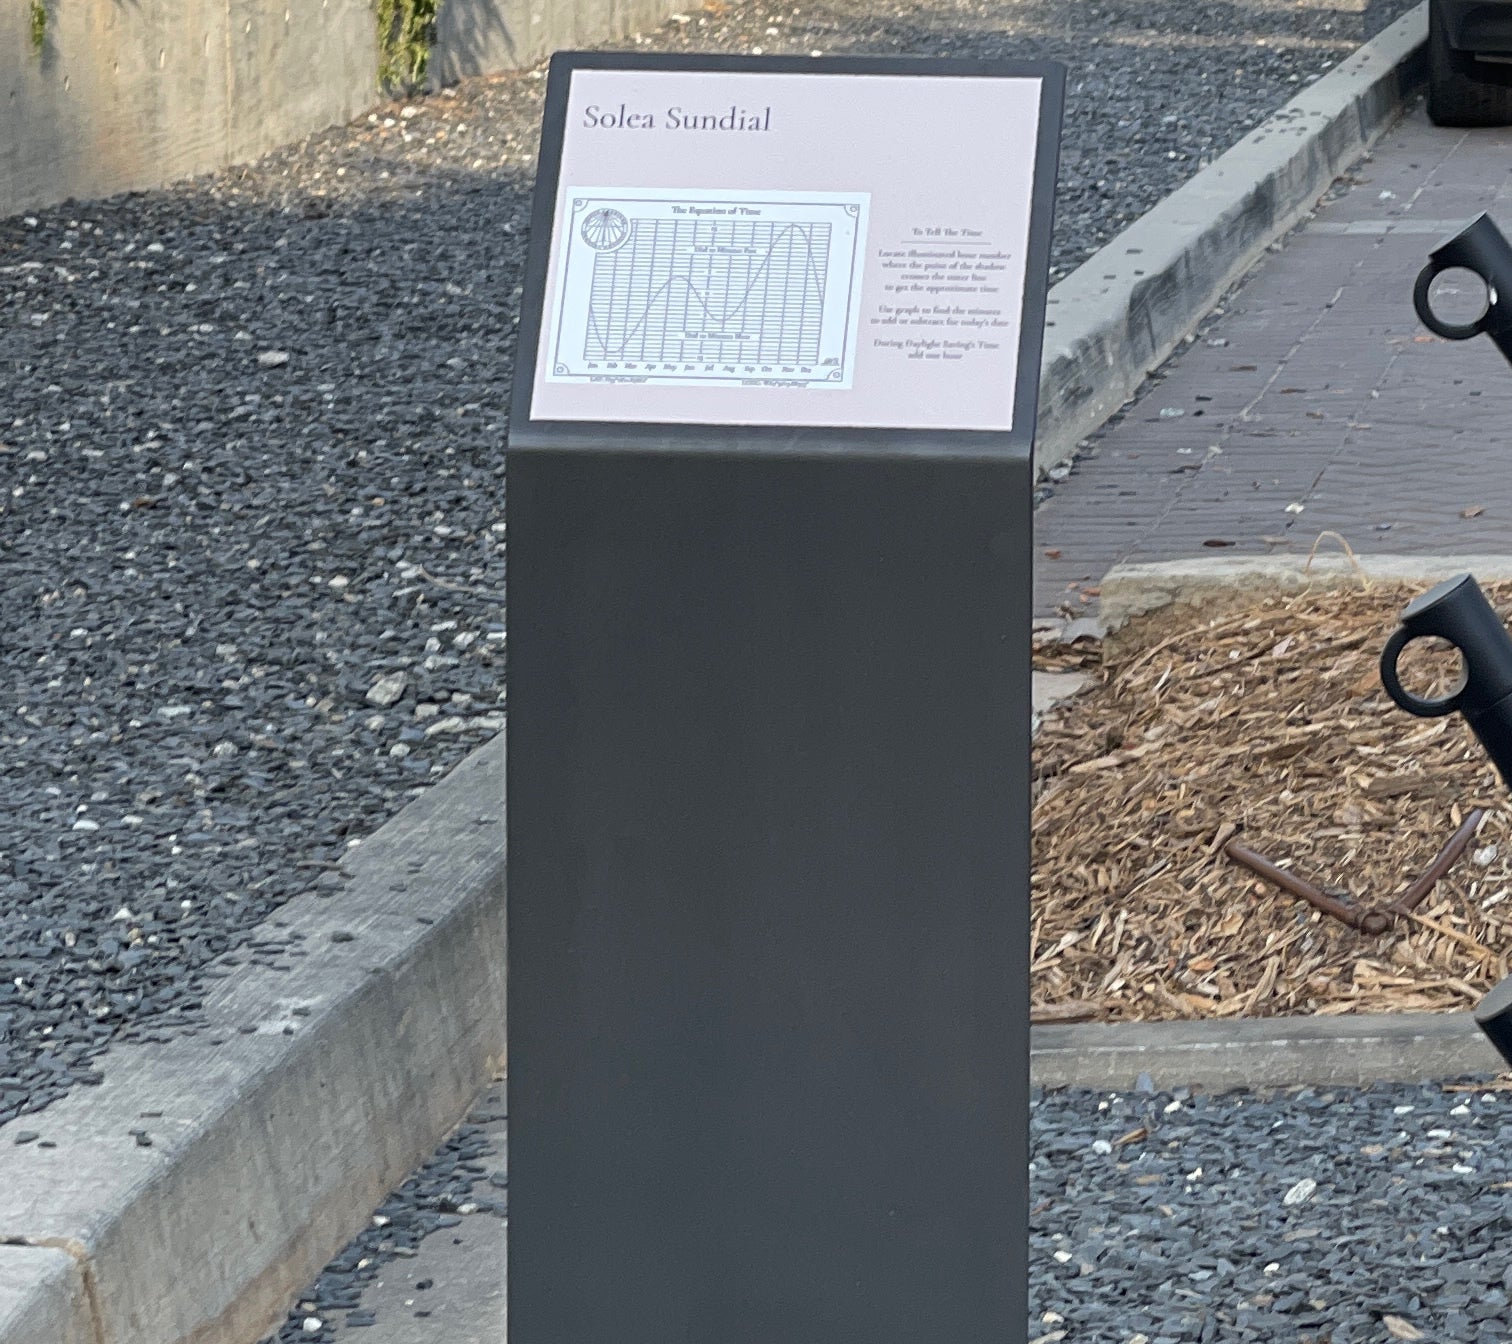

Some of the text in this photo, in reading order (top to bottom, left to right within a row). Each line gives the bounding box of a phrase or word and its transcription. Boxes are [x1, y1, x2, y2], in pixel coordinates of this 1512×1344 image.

[583, 103, 771, 132] Solea Sundial
[671, 206, 761, 216] The Equation of Time
[912, 228, 982, 237] To Tell The Time
[882, 261, 907, 269] where
[909, 261, 923, 269] the
[924, 262, 947, 271] point
[960, 262, 973, 270] the
[910, 284, 923, 292] the
[926, 286, 978, 294] approximate
[895, 306, 920, 316] graph
[952, 306, 965, 315] the
[882, 317, 898, 325] add
[905, 339, 941, 349] Daylight
[977, 341, 1000, 349] Time
